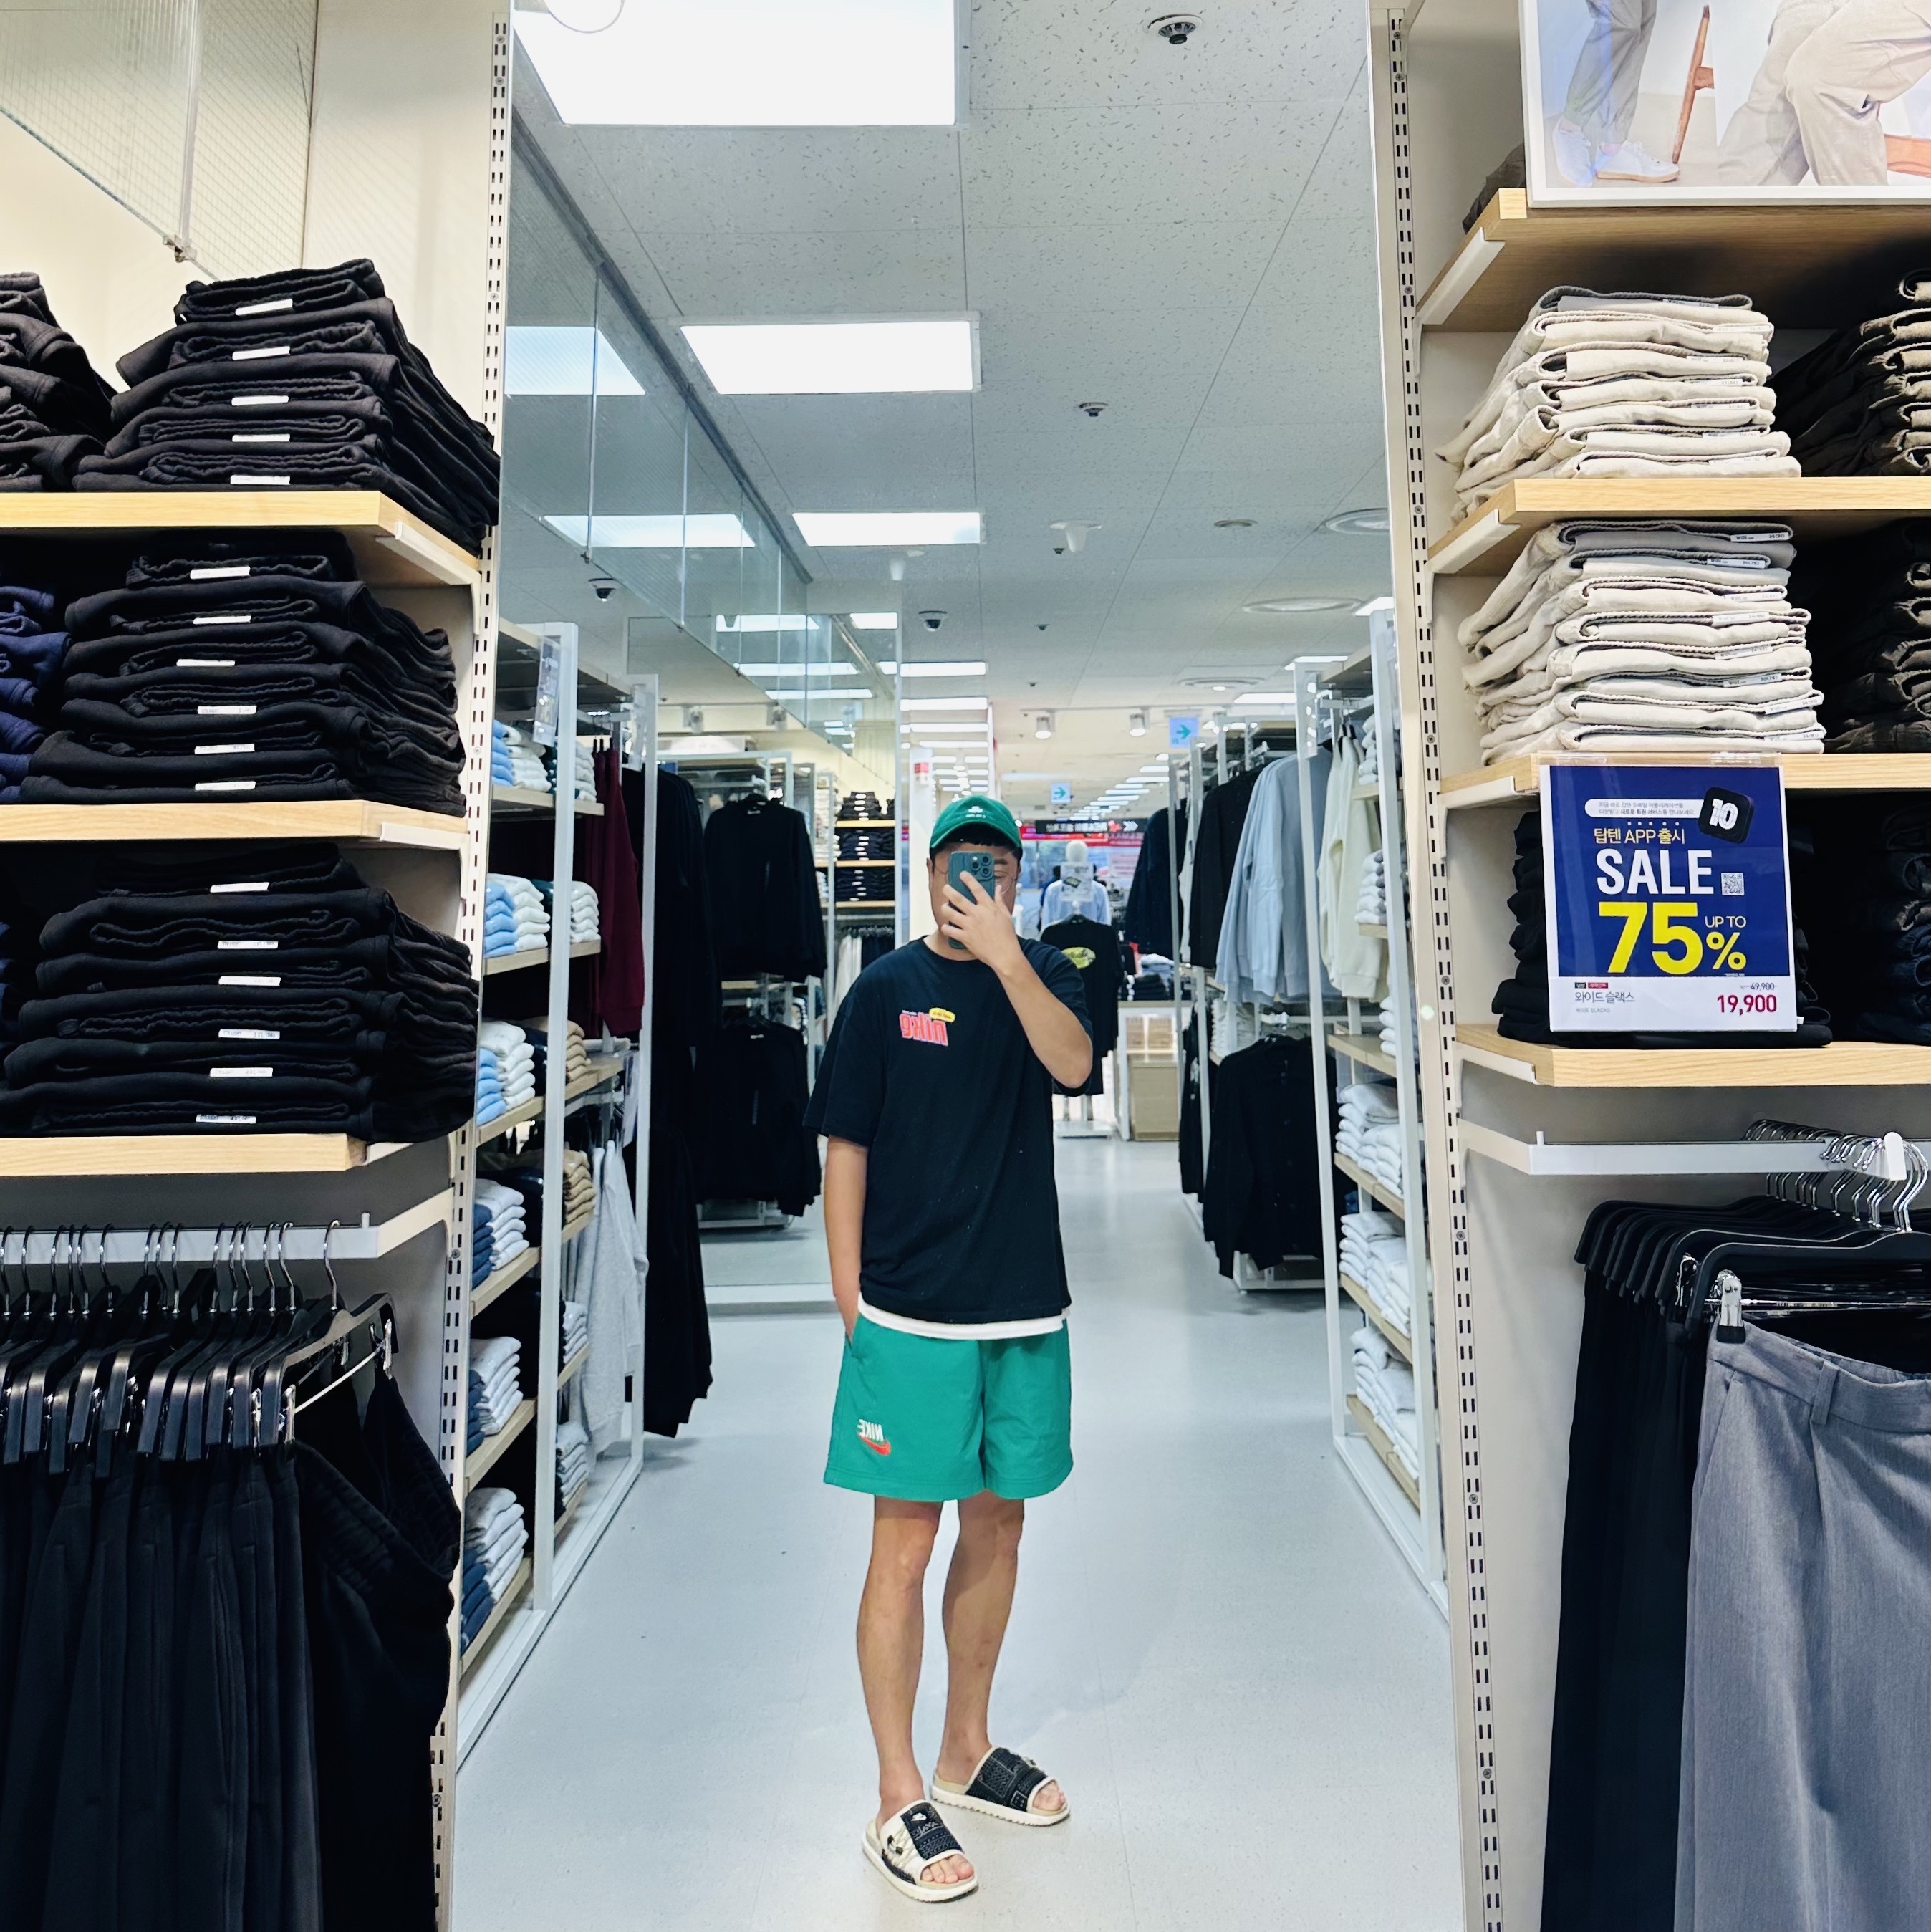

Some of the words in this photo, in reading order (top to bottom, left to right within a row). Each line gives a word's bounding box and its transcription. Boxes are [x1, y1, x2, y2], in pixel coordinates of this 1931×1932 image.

[1709, 798, 1738, 830] 10
[1594, 827, 1621, 844] 탑텐
[1624, 829, 1656, 844] APP
[1657, 828, 1685, 844] 출시
[1597, 848, 1714, 895] SALE
[1705, 915, 1724, 928] UP
[1726, 915, 1746, 928] TO
[1750, 982, 1775, 991] 49,900
[1575, 991, 1605, 1003] 와이드
[1606, 991, 1635, 1003] 슬랙스
[1718, 994, 1777, 1016] 19,900
